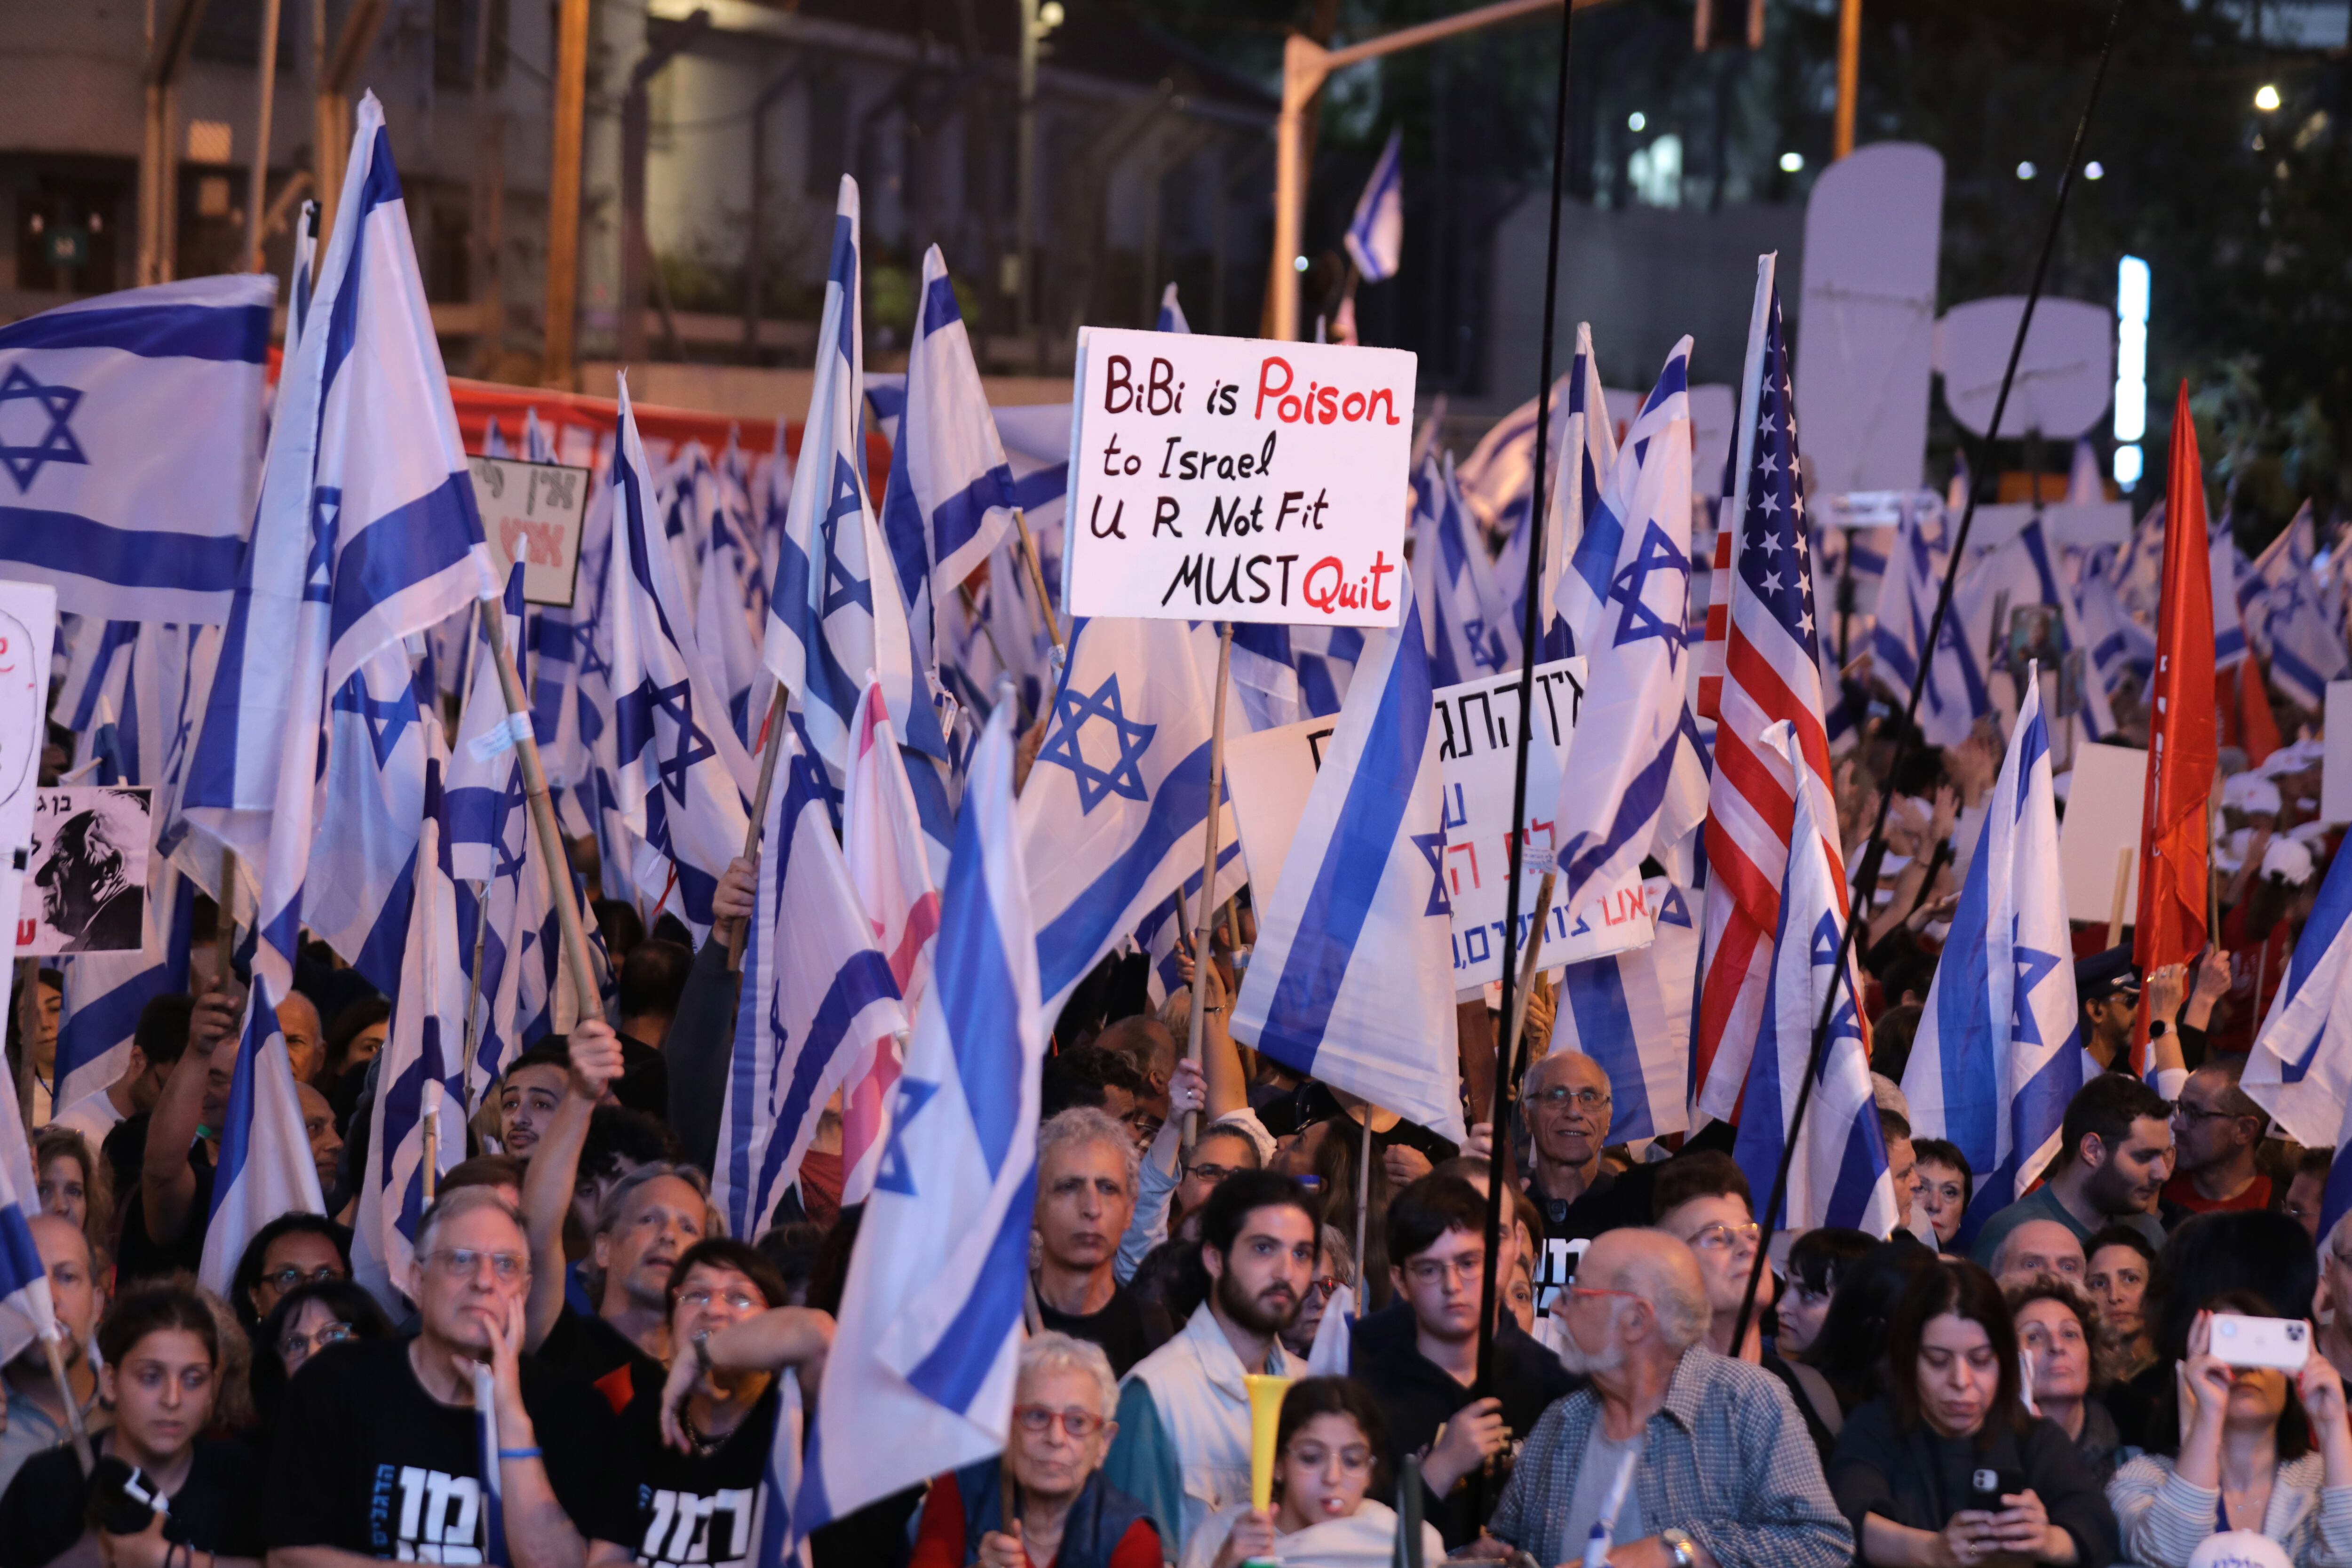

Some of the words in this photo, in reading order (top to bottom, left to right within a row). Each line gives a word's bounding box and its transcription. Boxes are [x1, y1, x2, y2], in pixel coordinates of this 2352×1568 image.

[1104, 355, 1185, 415] BiBi
[1207, 379, 1239, 415] is
[1255, 356, 1400, 425] Poison
[1103, 433, 1141, 476] to
[1159, 430, 1277, 481] Israel
[1152, 496, 1182, 537] R
[1205, 495, 1263, 537] Not
[1275, 487, 1329, 532] Fit
[1162, 552, 1299, 607] MUST
[1303, 550, 1394, 614] Quit
[52, 795, 72, 816] בן
